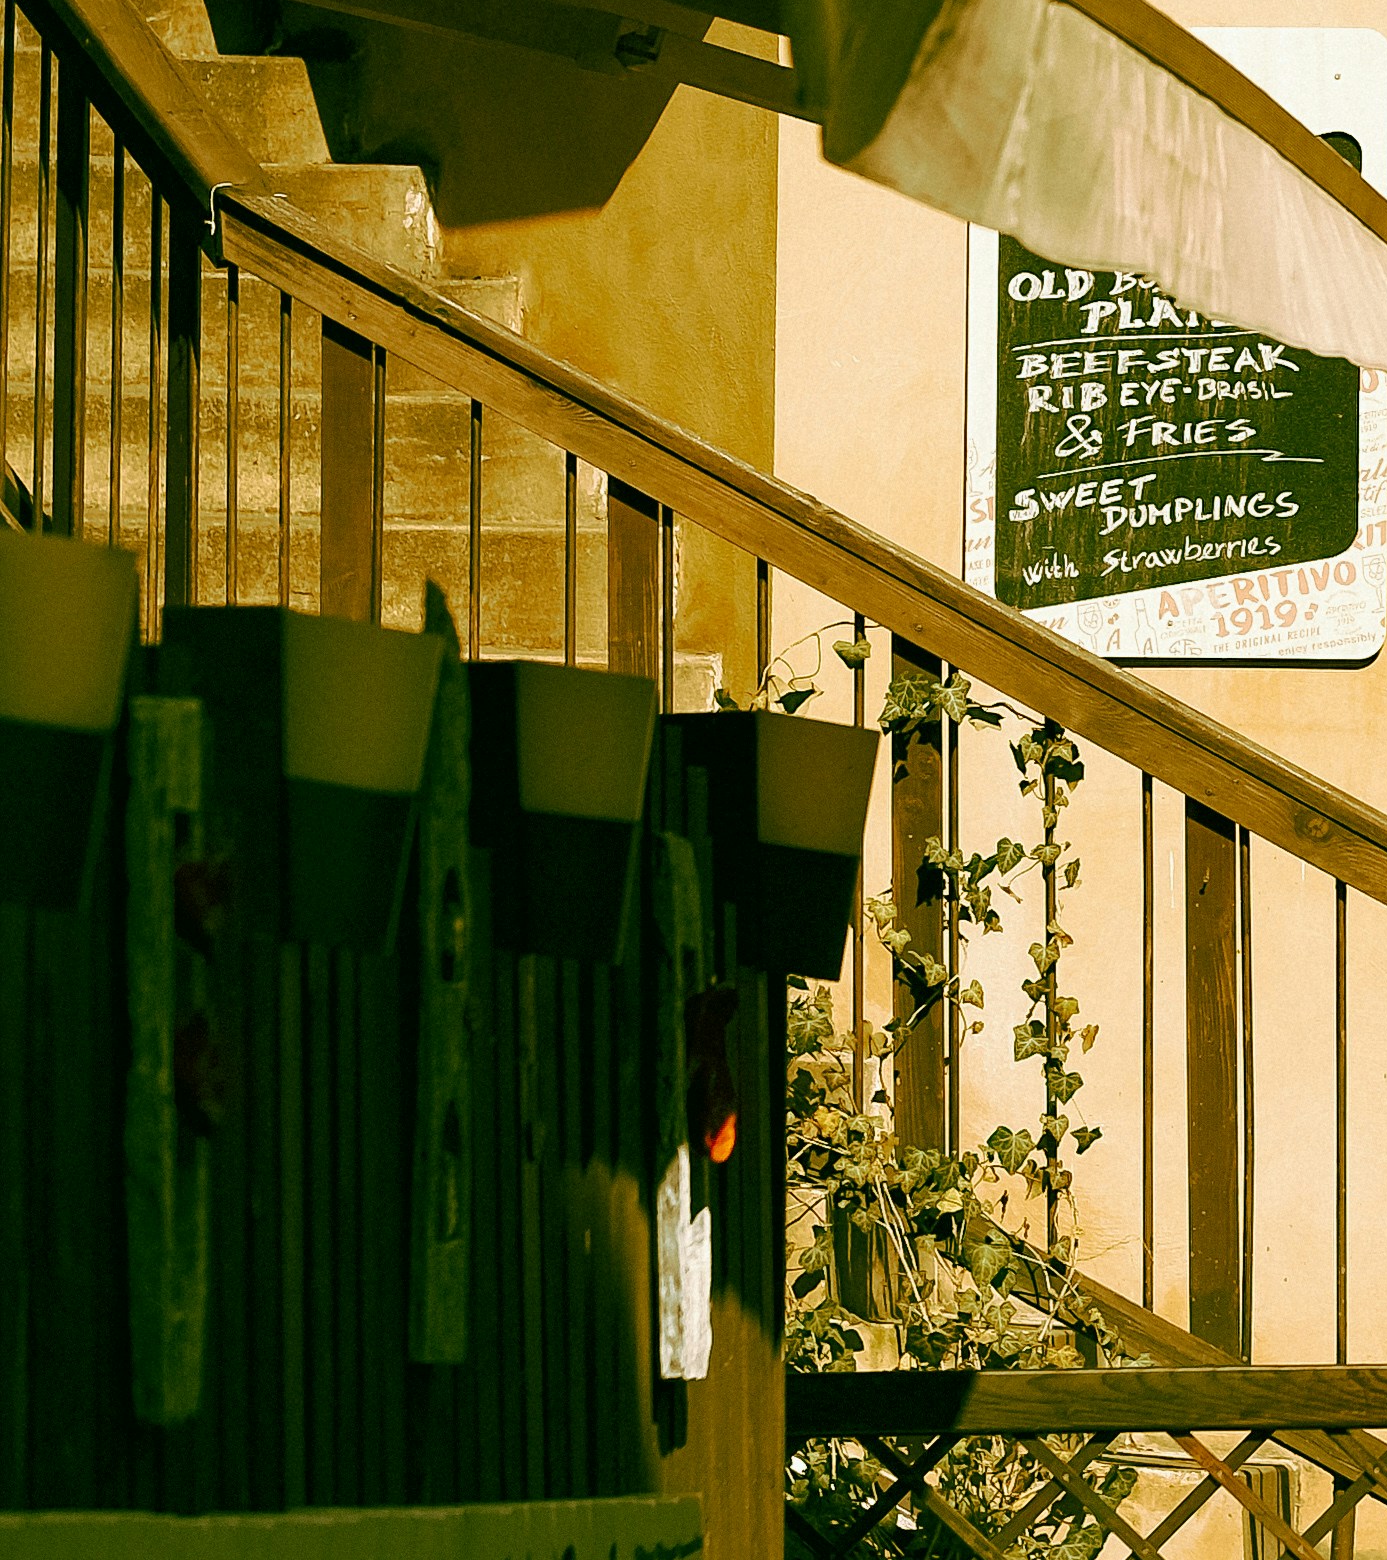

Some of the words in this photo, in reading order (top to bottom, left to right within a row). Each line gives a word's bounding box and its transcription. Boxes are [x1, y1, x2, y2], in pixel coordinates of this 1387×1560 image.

[1008, 270, 1094, 302] OLD
[1016, 344, 1300, 380] BEEFSTEAK
[1028, 381, 1108, 414] RIB
[1054, 414, 1102, 460] &
[1117, 415, 1256, 447] FRIES
[1008, 473, 1157, 522] SWEET
[1098, 491, 1300, 536] DUMPLINGS
[1159, 560, 1356, 620] APERITIVO
[1235, 633, 1281, 650] ORIGINAL
[1312, 631, 1377, 650] responsibly
